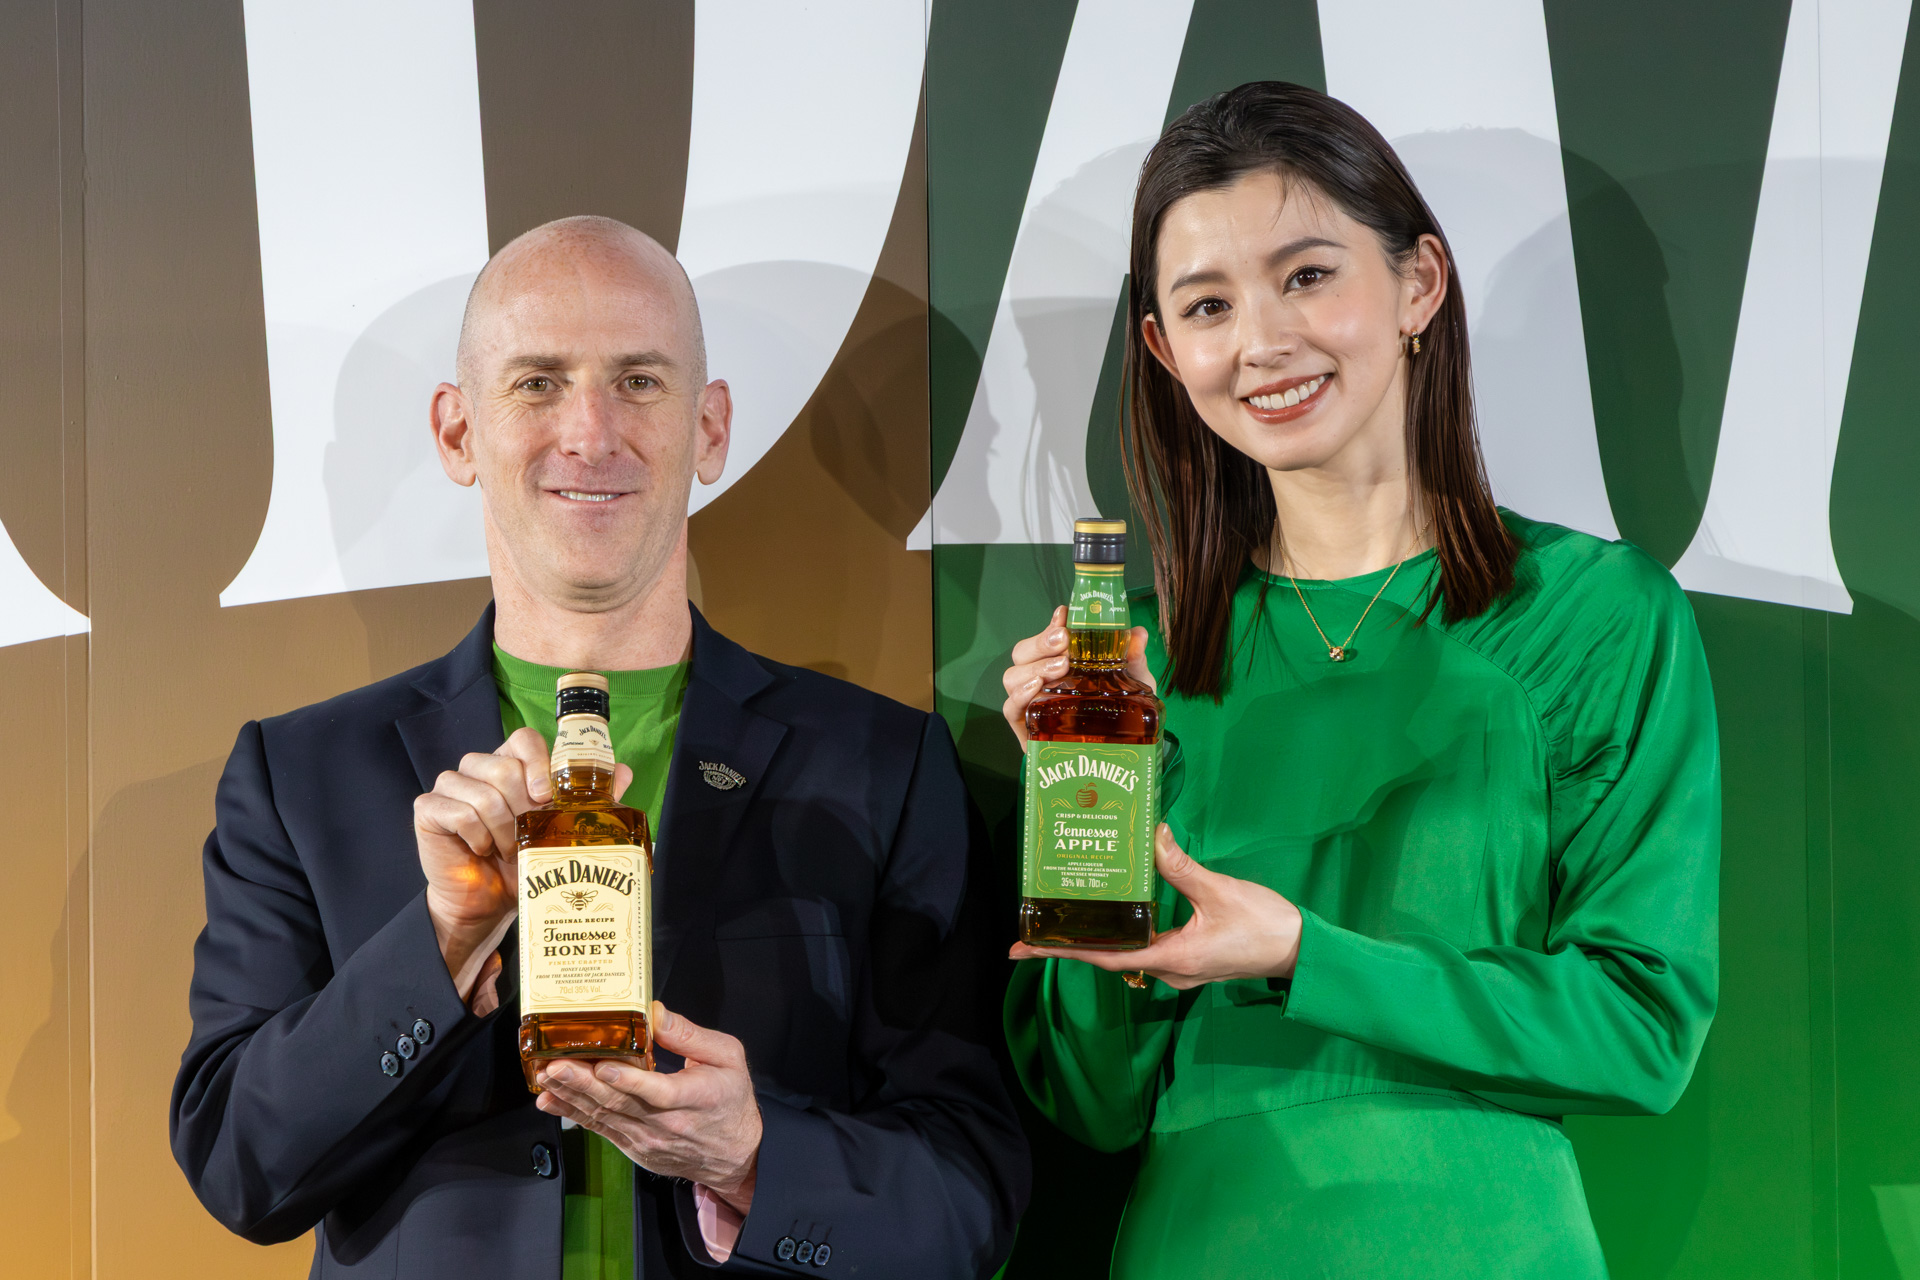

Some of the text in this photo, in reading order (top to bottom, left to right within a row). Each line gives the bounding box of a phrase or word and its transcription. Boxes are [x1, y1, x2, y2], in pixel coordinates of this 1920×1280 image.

[578, 726, 590, 736] JACK
[699, 761, 718, 770] JACK
[1037, 760, 1077, 789] JACK
[1078, 754, 1139, 792] DANIEL'S
[1053, 821, 1118, 838] Tennessee
[1054, 838, 1118, 852] APPLE
[525, 860, 637, 899] JACK DANIEL'S
[1061, 877, 1074, 887] 35%
[543, 927, 617, 943] Tennessee
[543, 943, 617, 957] HONEY
[559, 986, 574, 994] 70cl
[575, 985, 589, 993] 35%
